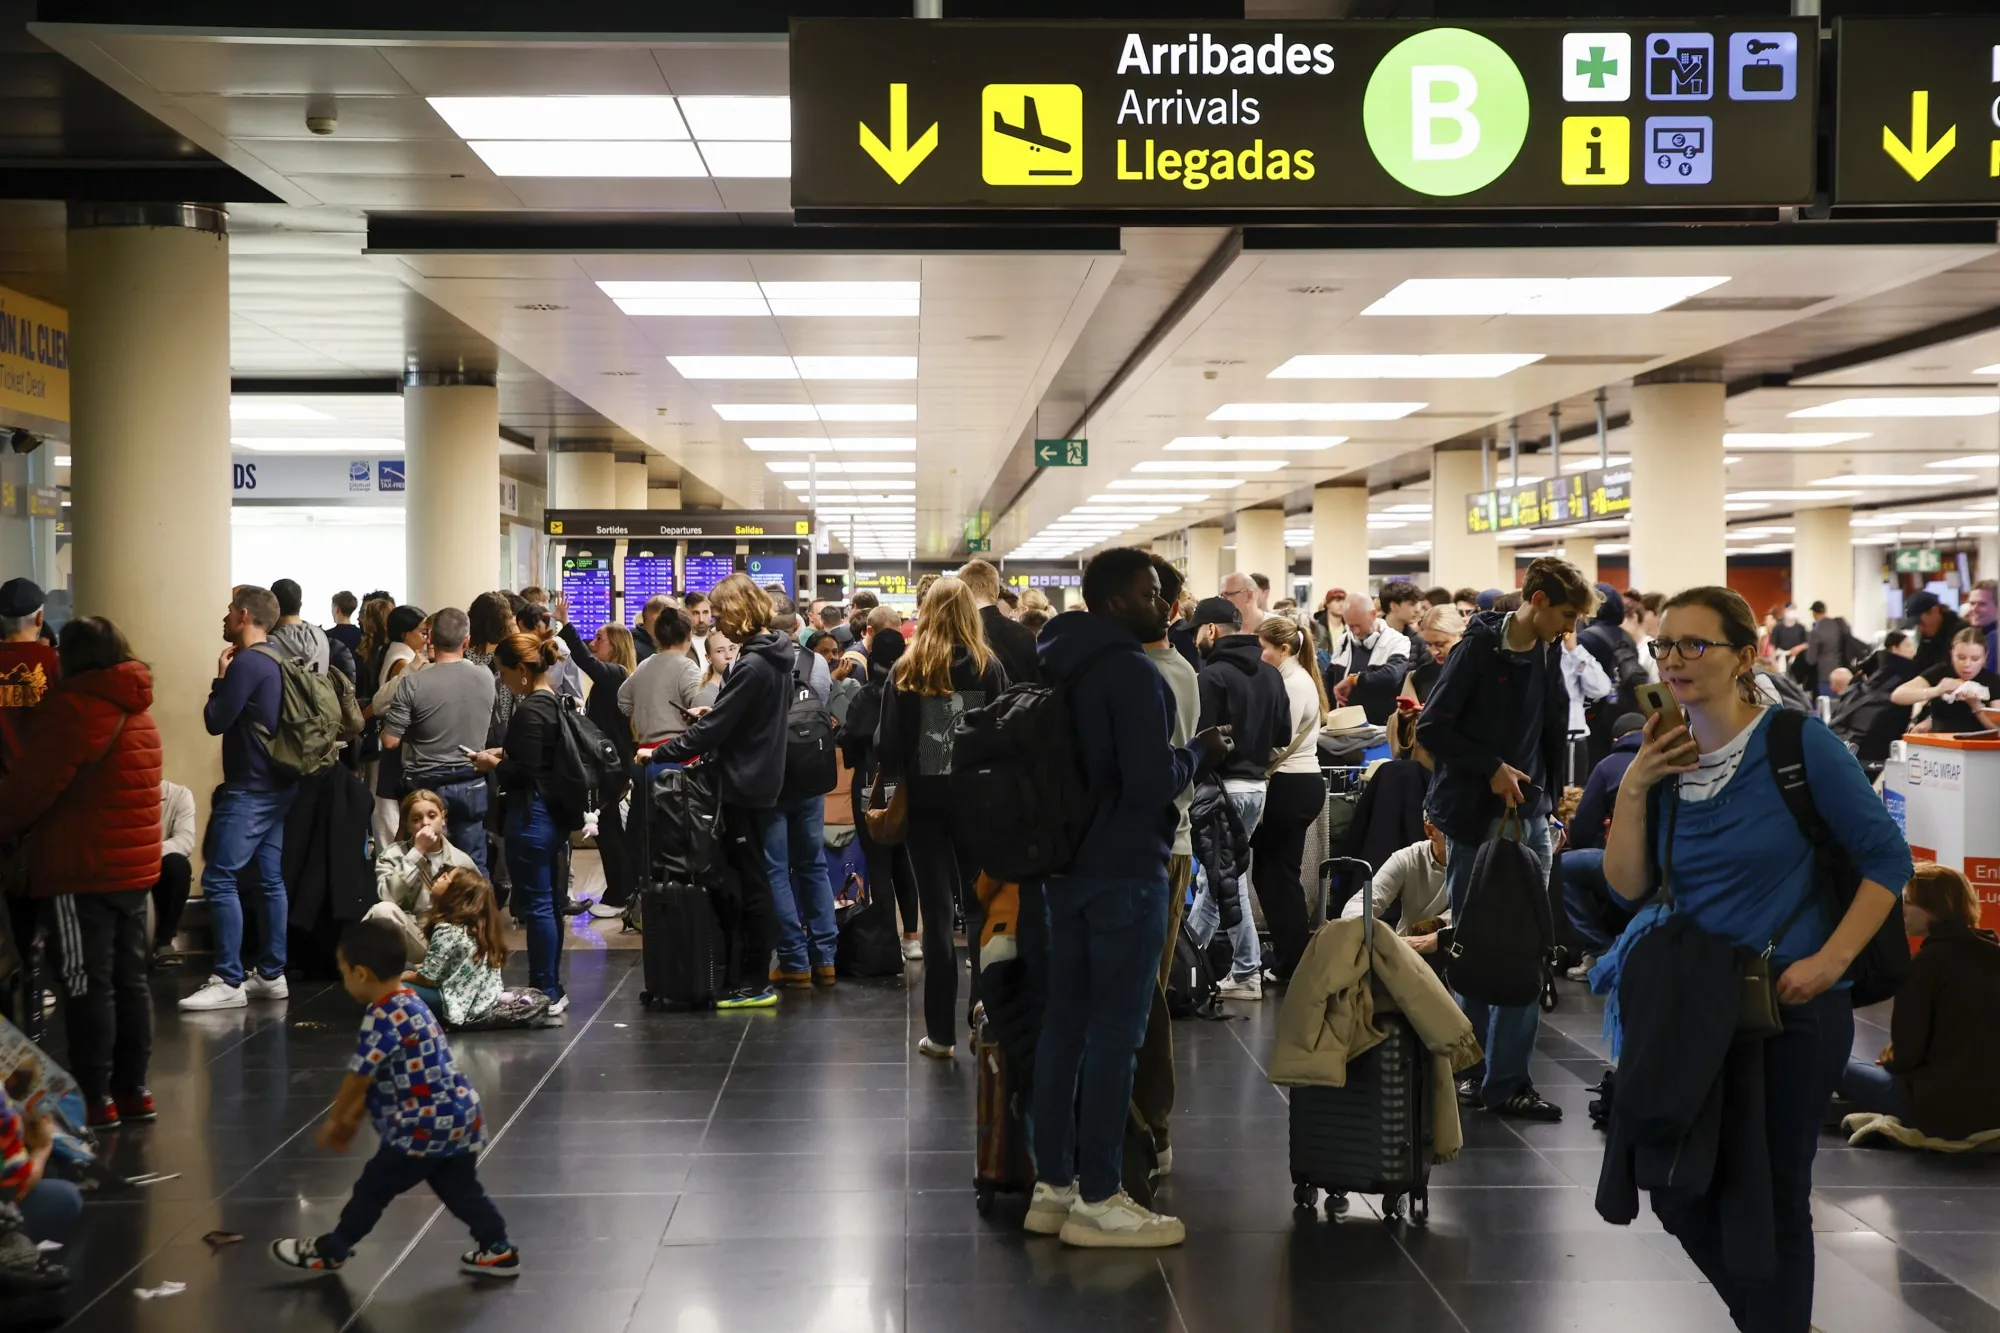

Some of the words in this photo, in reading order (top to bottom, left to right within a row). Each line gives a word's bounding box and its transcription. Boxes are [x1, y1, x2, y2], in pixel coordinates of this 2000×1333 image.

[1117, 33, 1335, 75] Arribades
[1117, 88, 1261, 125] Arrivals
[1410, 64, 1482, 163] B
[1117, 138, 1316, 190] Llegadas
[20, 317, 35, 361] AL
[26, 371, 46, 399] Desk
[596, 525, 629, 534] Sortides
[660, 525, 703, 536] Departures
[735, 525, 764, 535] Salidas
[1923, 760, 1939, 778] BAG
[1940, 763, 1962, 781] WRAP
[1976, 889, 2000, 904] Lu
